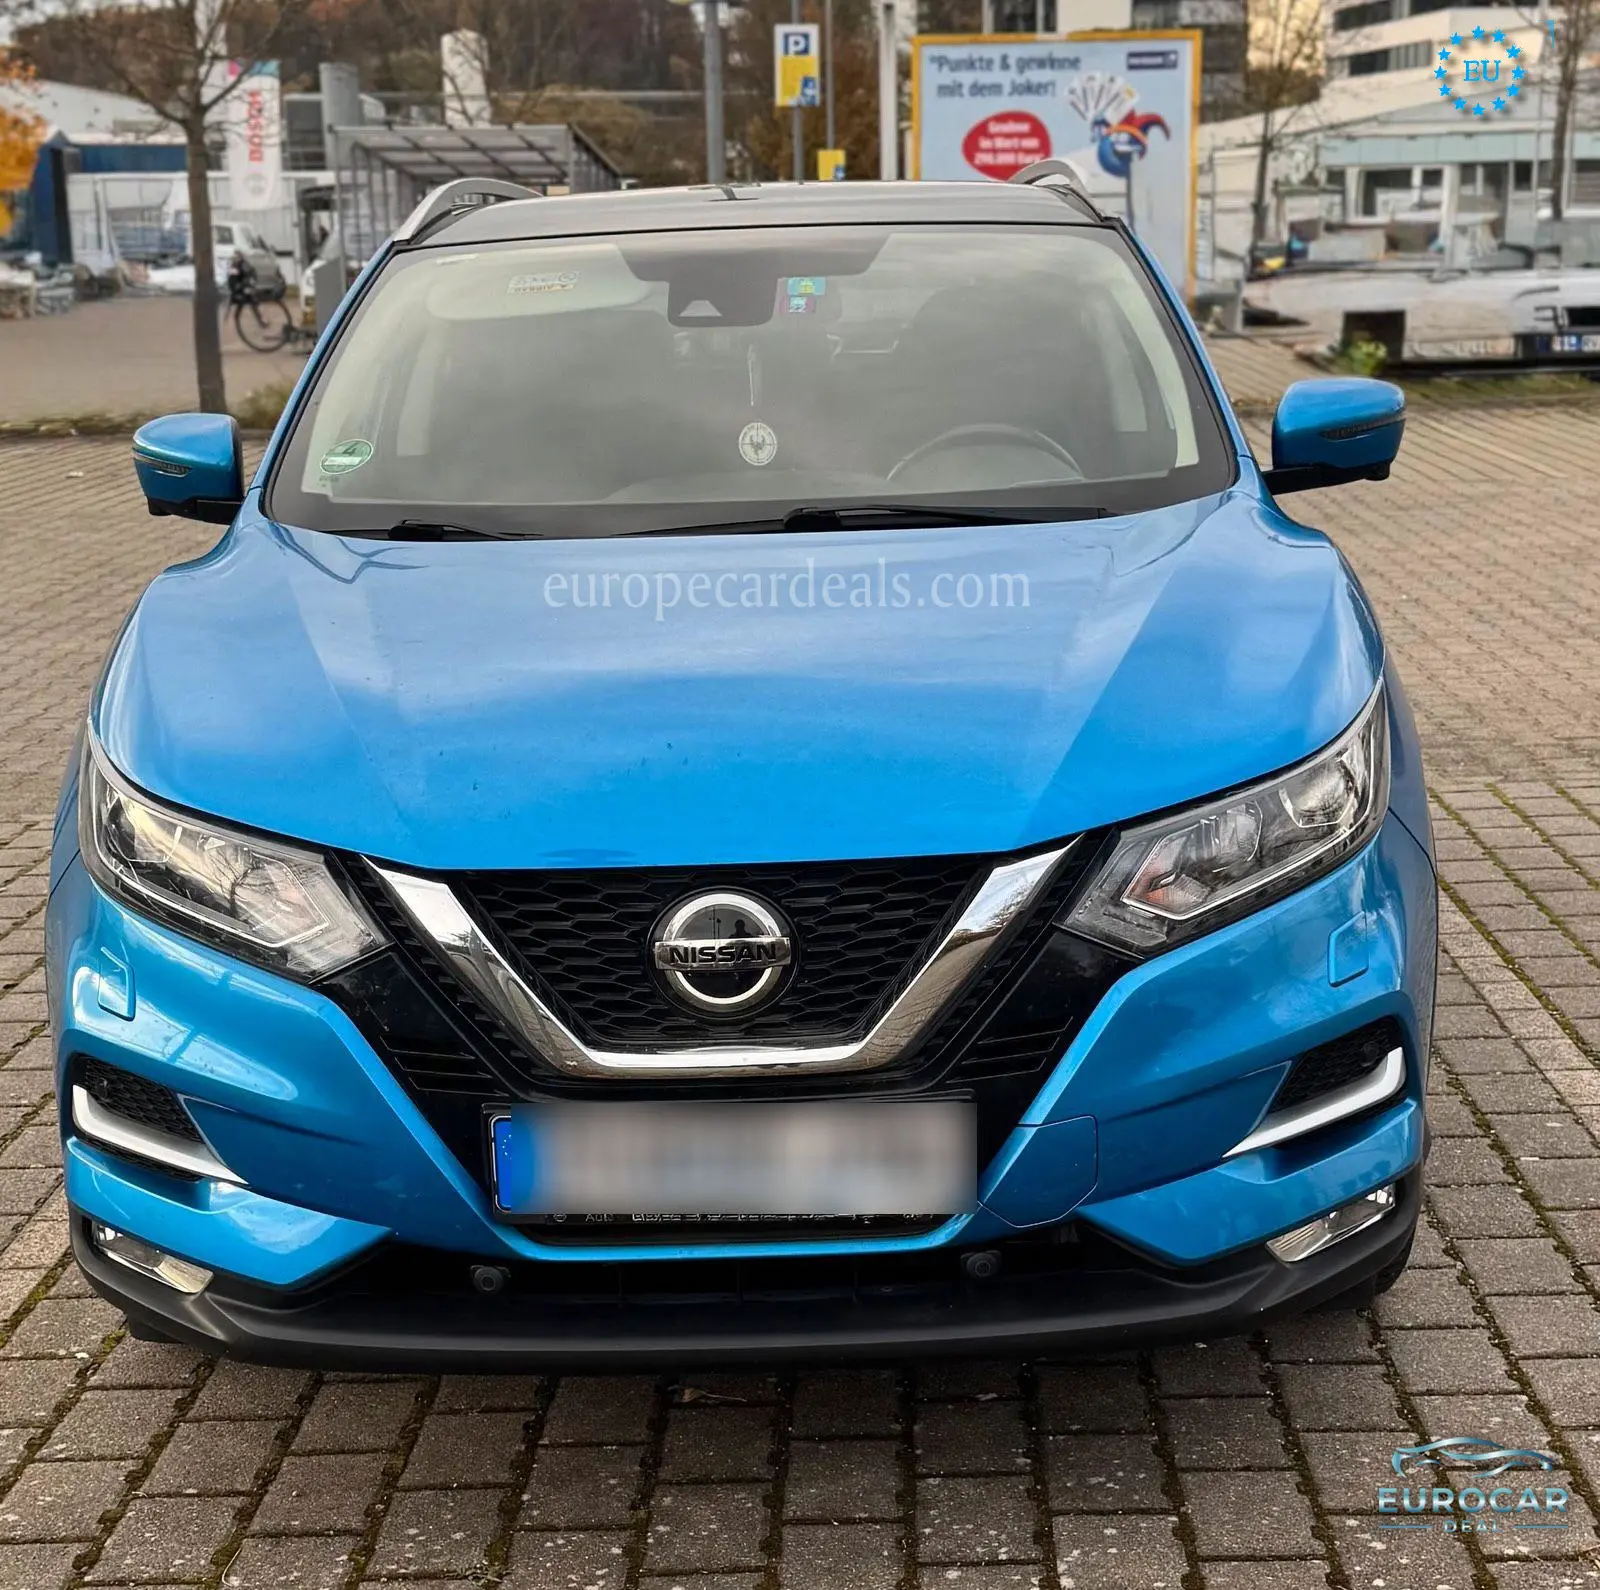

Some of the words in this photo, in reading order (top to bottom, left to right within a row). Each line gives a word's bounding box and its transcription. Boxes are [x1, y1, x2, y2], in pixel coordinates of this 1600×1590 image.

[787, 34, 807, 55] P
[999, 52, 1011, 71] &
[1016, 52, 1081, 75] gewinne
[937, 79, 964, 98] mit
[968, 78, 1003, 97] dem
[342, 441, 358, 456] 4
[669, 944, 777, 964] NISSAN
